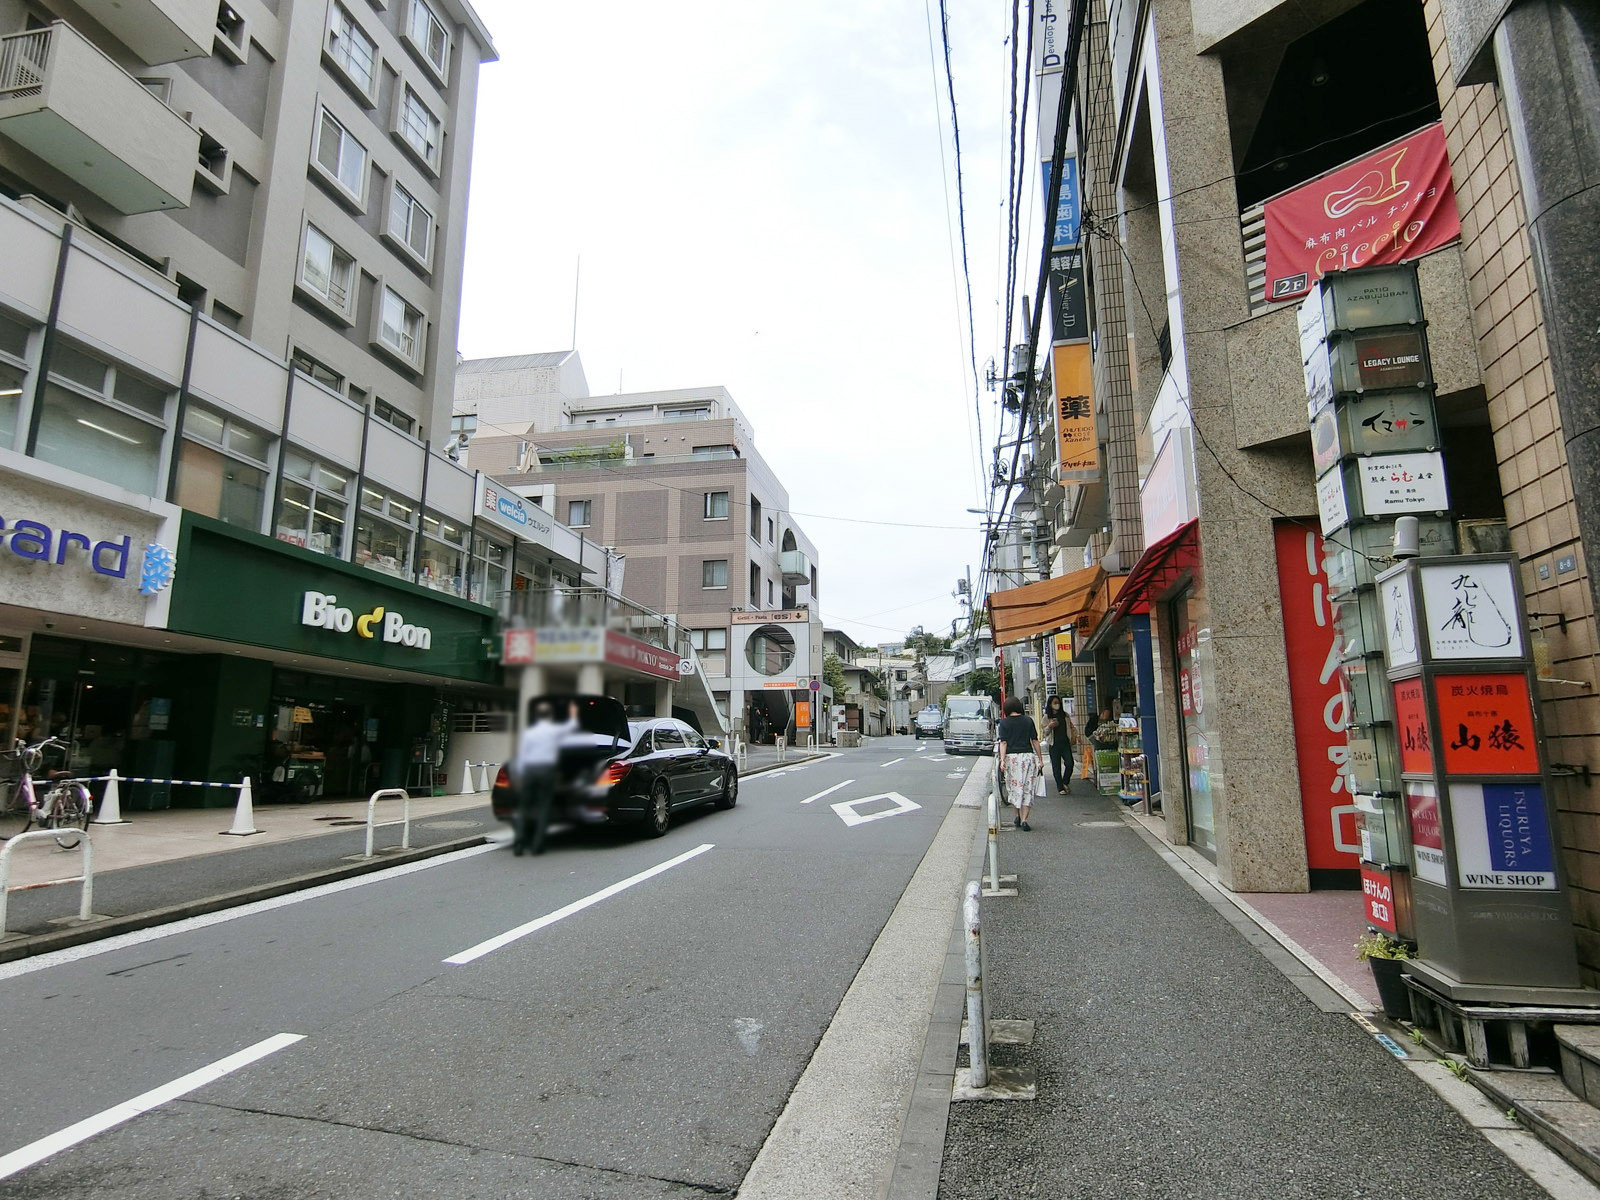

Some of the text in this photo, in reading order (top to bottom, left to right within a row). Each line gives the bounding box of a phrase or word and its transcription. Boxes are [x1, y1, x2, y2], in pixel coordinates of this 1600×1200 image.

[1043, 25, 1060, 67] Develop
[1304, 215, 1377, 250] 麻布肉バル
[1278, 280, 1304, 294] 2F
[1363, 286, 1389, 294] PATIO
[1347, 290, 1408, 302] AZABUJUBAN
[1363, 357, 1391, 368] LEGACY
[1392, 354, 1419, 365] LOUNGE
[1060, 395, 1091, 420] 薬
[1062, 426, 1094, 434] SHISEIDO
[500, 501, 525, 523] welcia
[1559, 559, 1571, 569] 8-8
[302, 591, 353, 632] Bio
[383, 612, 431, 649] Bon
[1451, 684, 1509, 697] 炭火焼鳥
[1514, 791, 1532, 855] TSURUYA
[1499, 805, 1518, 867] LIQUORS
[1416, 851, 1431, 862] WINE
[1466, 874, 1545, 885] WINE SHOP
[1363, 878, 1390, 902] ほけんの
[1371, 901, 1389, 922] 窓口
